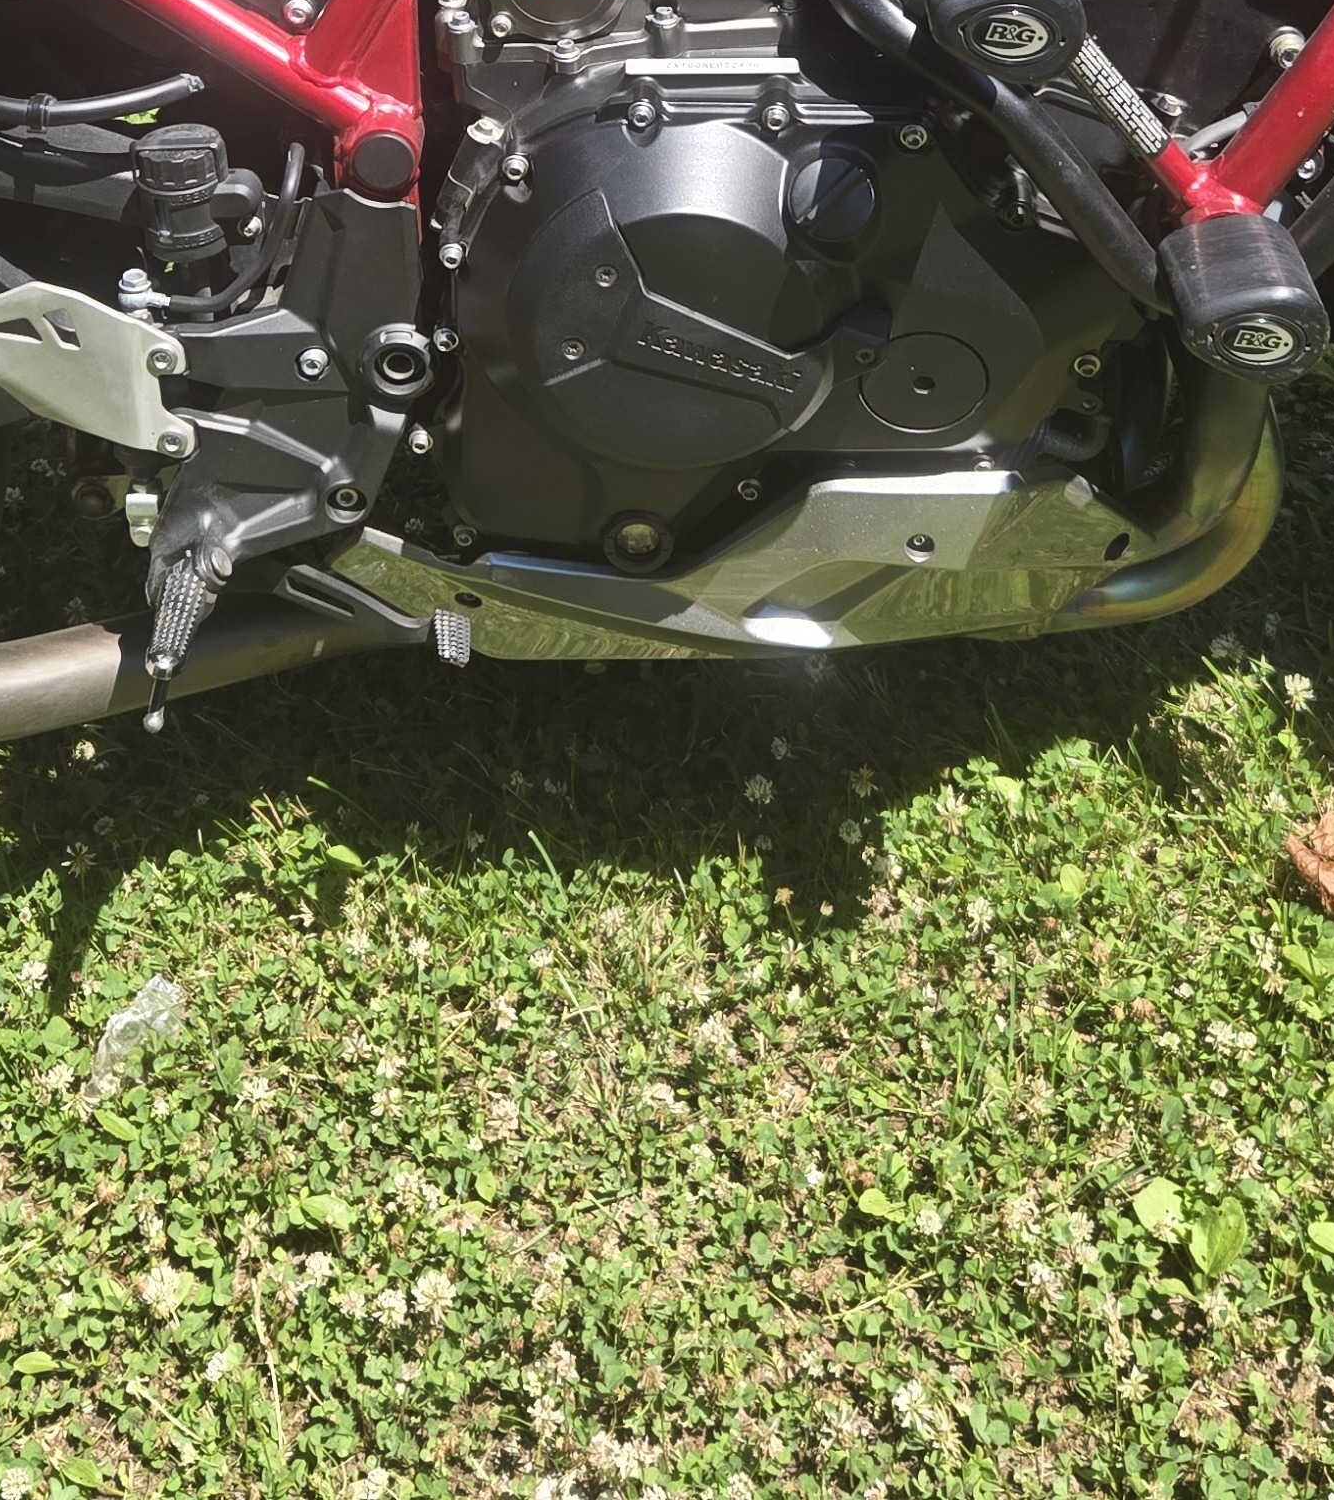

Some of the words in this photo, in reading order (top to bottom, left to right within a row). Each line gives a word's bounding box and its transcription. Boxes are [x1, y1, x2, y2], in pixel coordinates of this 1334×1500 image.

[988, 24, 1037, 44] R&G
[1237, 331, 1283, 350] R&G
[637, 322, 802, 394] Kawasaki
